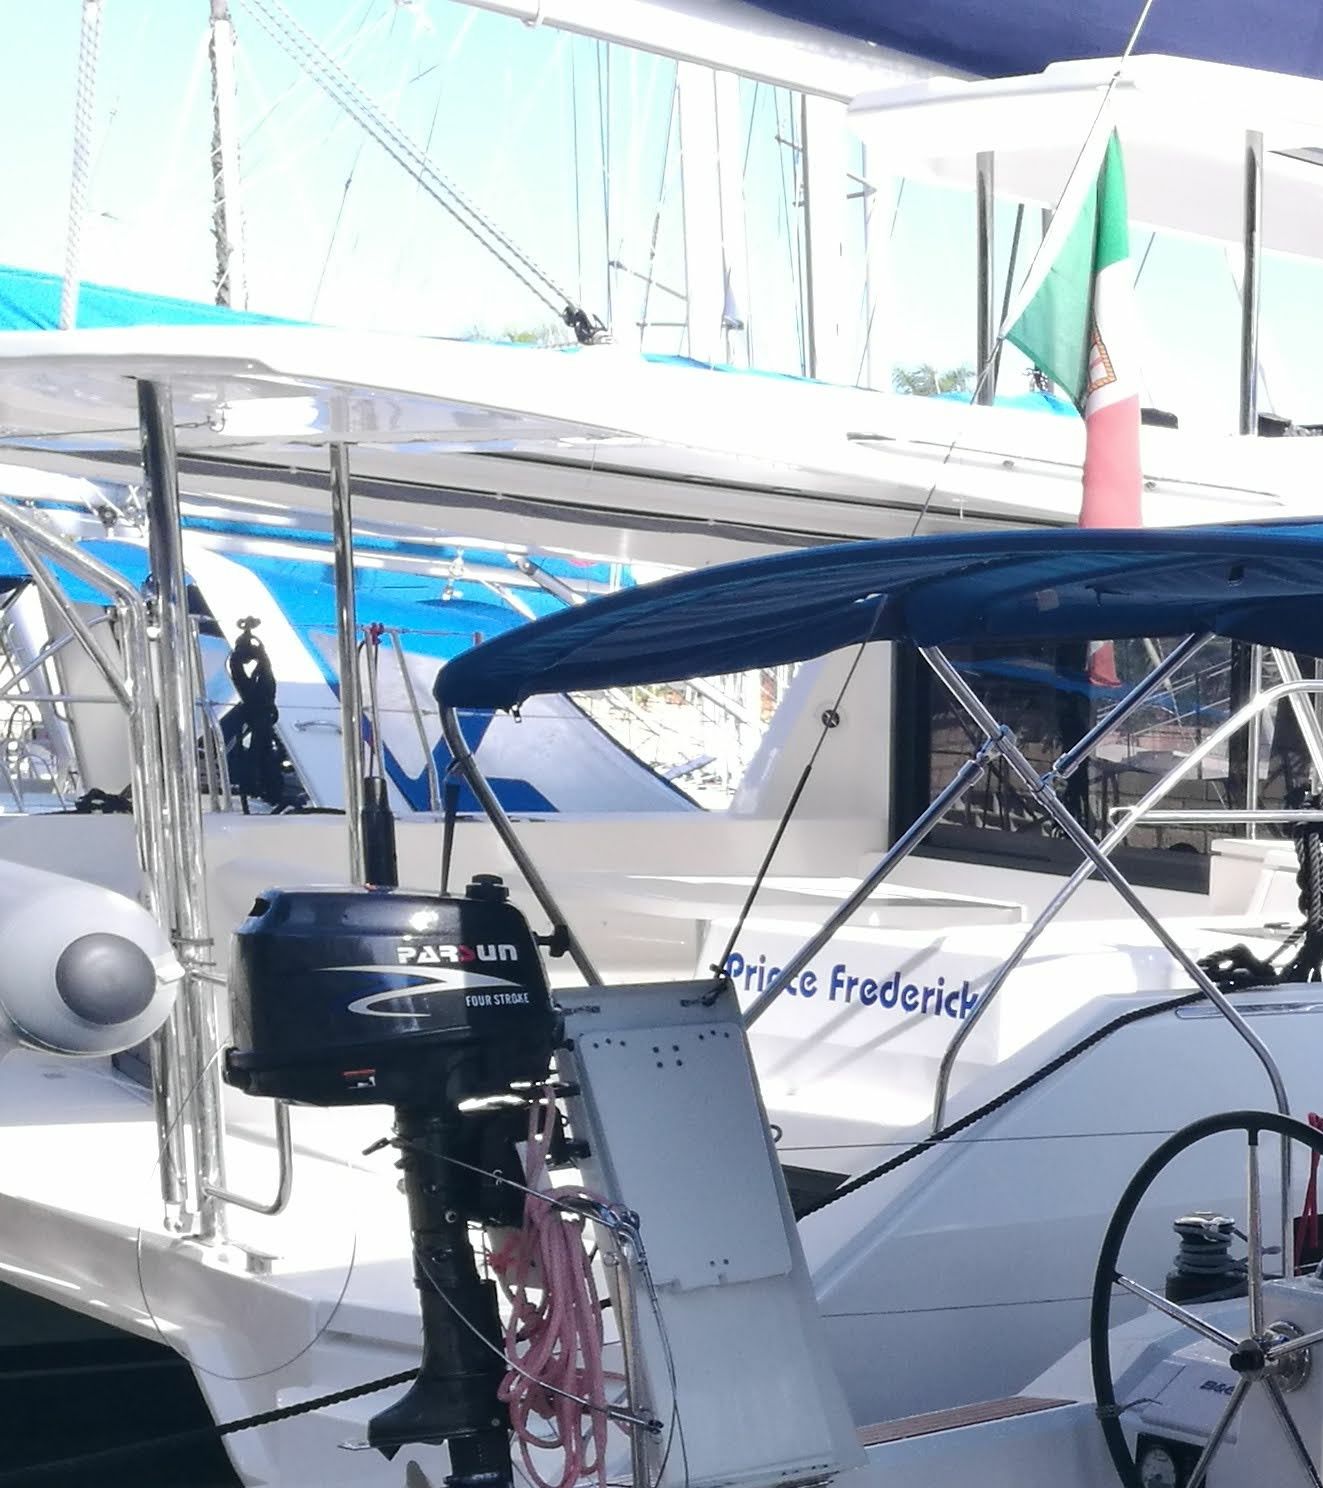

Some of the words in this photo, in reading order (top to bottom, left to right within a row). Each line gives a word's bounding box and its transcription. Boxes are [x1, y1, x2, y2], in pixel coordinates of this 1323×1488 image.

[465, 995, 492, 1007] FOUR
[493, 992, 530, 1005] STROKE
[828, 963, 979, 1019] Frederick
